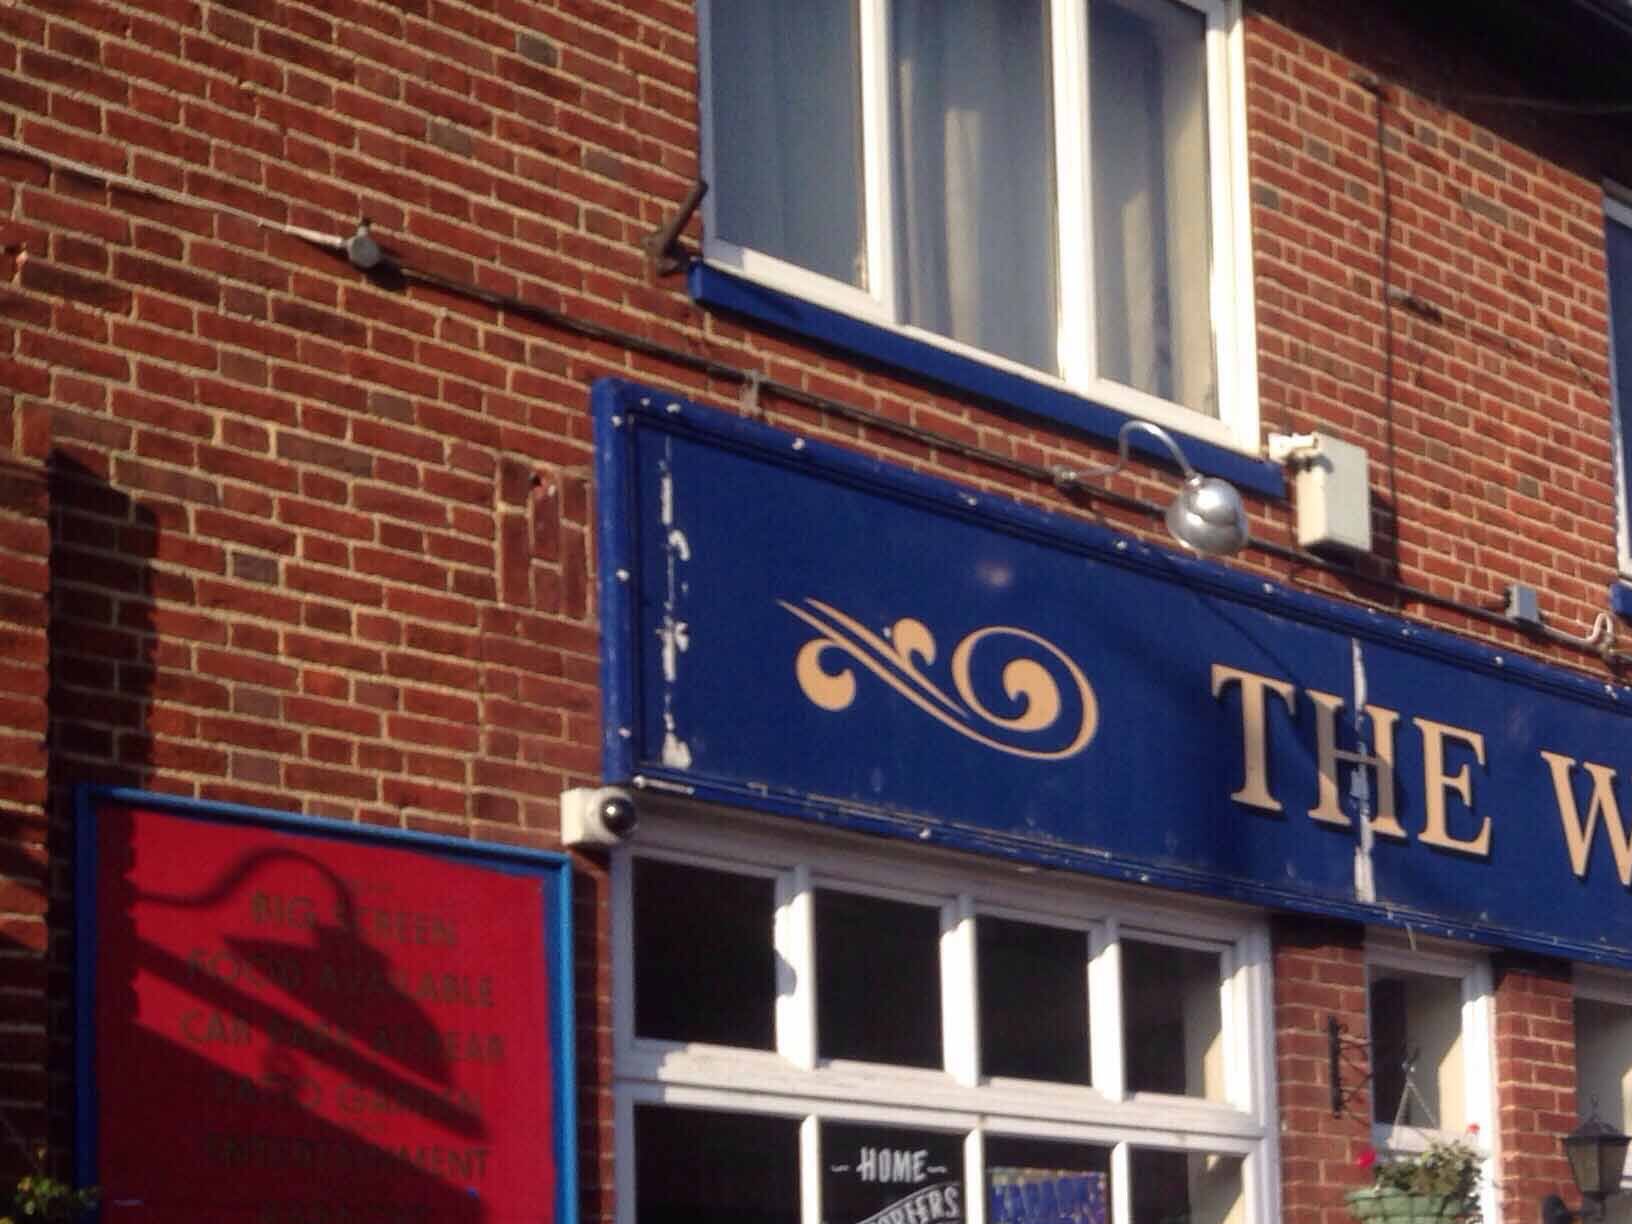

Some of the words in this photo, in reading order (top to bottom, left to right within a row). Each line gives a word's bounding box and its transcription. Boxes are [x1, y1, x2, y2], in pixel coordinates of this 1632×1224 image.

[1211, 664, 1491, 856] THE
[250, 889, 316, 931] BIG
[331, 898, 459, 949] SCREEN
[186, 947, 301, 992] FOOD
[178, 1008, 252, 1048] CAR
[857, 1146, 929, 1183] HOME
